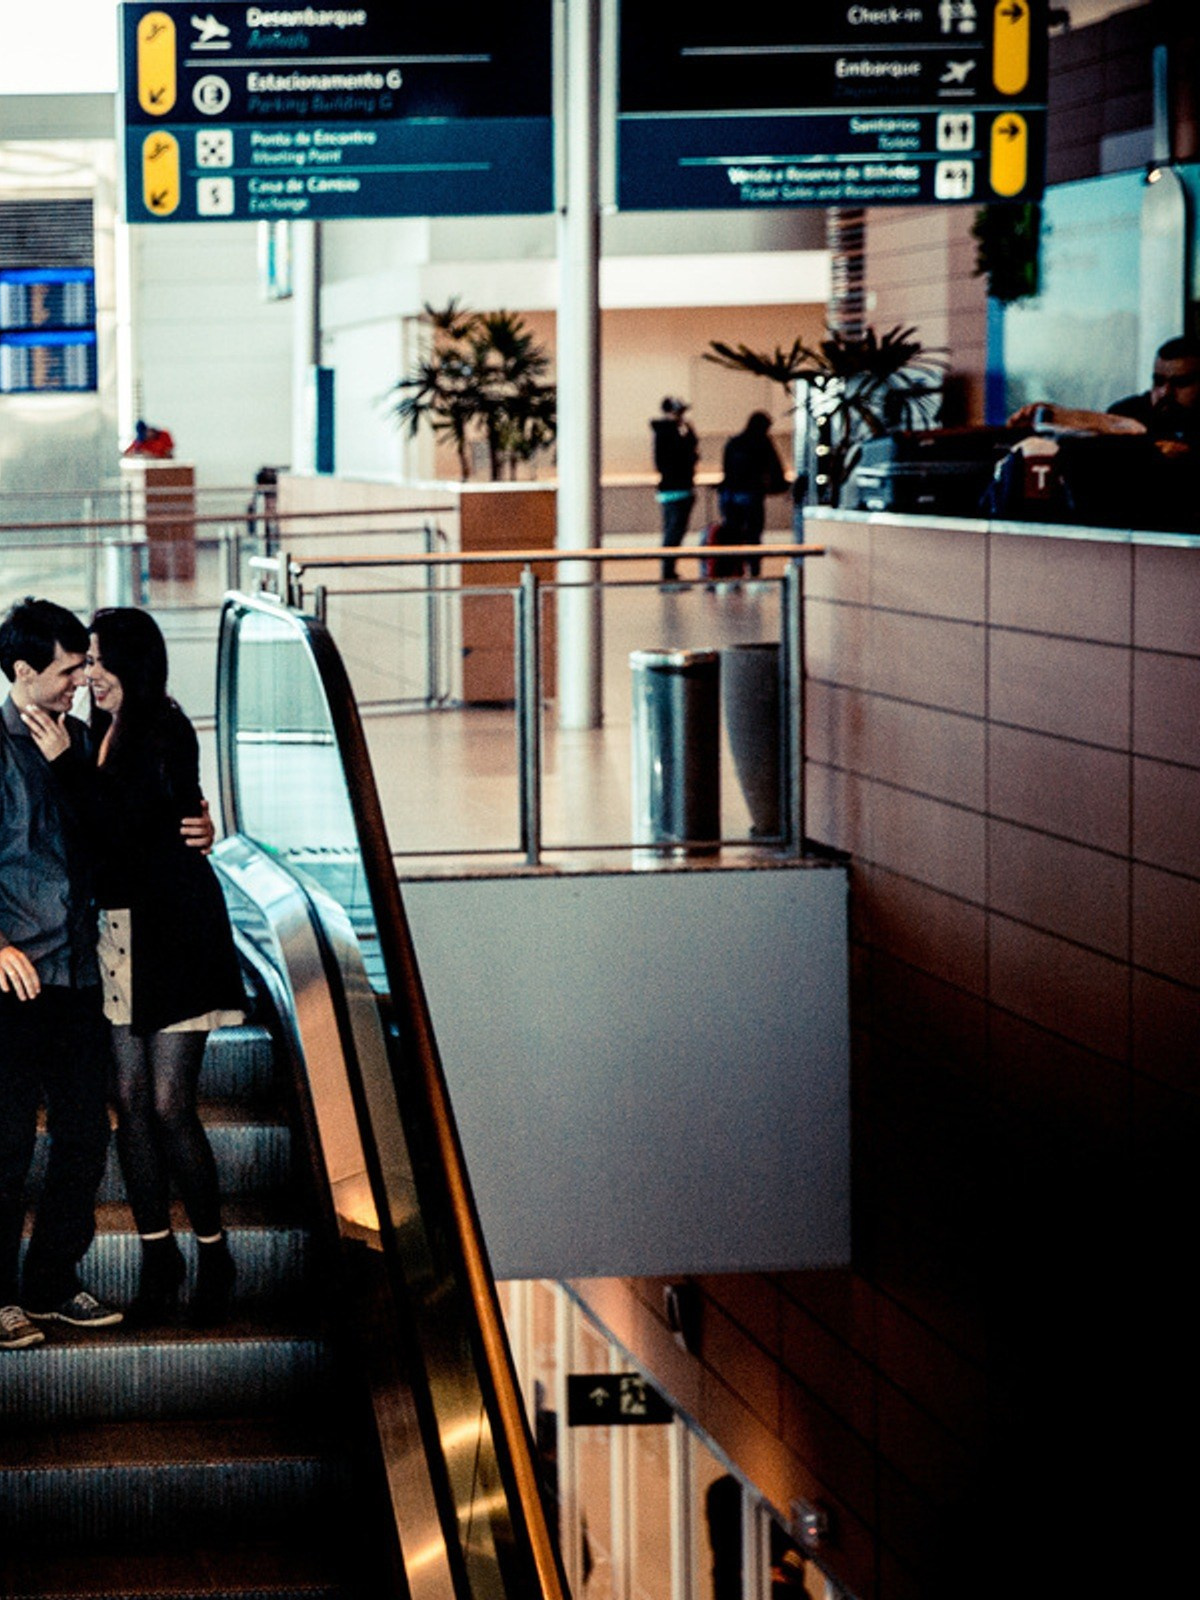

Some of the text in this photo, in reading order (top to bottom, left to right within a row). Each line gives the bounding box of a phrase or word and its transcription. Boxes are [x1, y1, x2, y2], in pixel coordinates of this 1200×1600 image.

[246, 6, 367, 29] Desembarque
[846, 4, 923, 25] Check-in
[834, 57, 922, 79] Embarque
[246, 68, 403, 92] Estacionamento G
[250, 128, 377, 147] Ponto de Encontro
[286, 177, 304, 193] de
[1031, 465, 1051, 490] T
